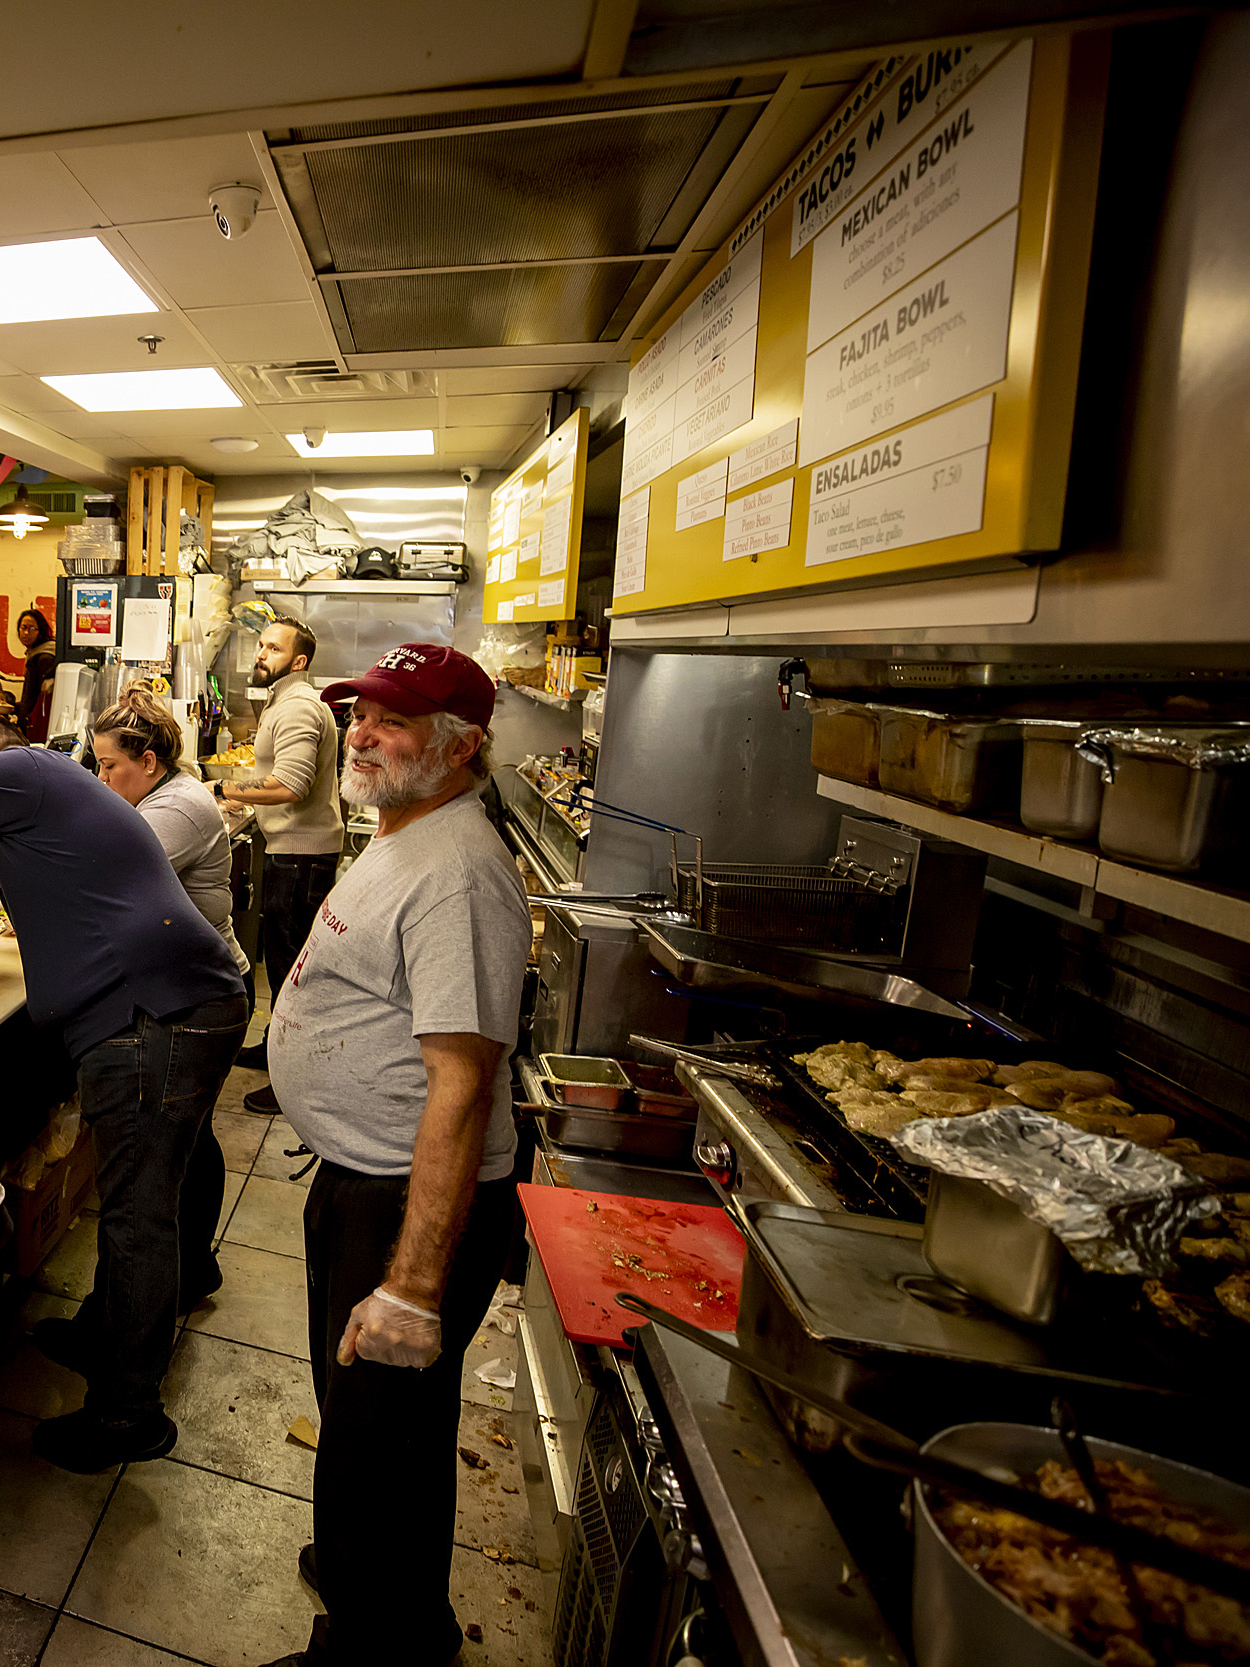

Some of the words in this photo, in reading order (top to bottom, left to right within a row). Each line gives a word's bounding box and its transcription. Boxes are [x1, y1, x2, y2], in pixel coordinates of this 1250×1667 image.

[798, 138, 857, 225] TACOS
[841, 163, 911, 247] MEXICAN
[917, 108, 974, 180] BOWL
[849, 229, 876, 264] choose
[913, 177, 936, 207] with
[844, 240, 895, 290] combination
[897, 222, 910, 248] of
[694, 307, 733, 355] CAMARONES
[839, 317, 890, 371] FAJITA
[896, 279, 950, 336] BOWL
[694, 356, 726, 394] CARNITAS
[848, 361, 880, 388] chicken,
[687, 394, 730, 437] VEGETARIANO
[846, 389, 872, 413] onions
[870, 396, 895, 424] $9.95
[745, 444, 765, 461] Mexican
[767, 435, 778, 449] Rice
[750, 465, 763, 480] Lime
[764, 456, 780, 472] White
[781, 450, 793, 464] Rice
[816, 439, 903, 495] ENSALADAS
[932, 463, 963, 491] $7.50
[742, 497, 756, 512] Black
[757, 493, 773, 506] Beans
[813, 510, 830, 525] Taco
[831, 499, 850, 520] Salad
[741, 518, 755, 532] Pinto
[756, 514, 771, 527] Beans
[827, 525, 838, 537] one
[839, 519, 855, 537] meat,
[856, 514, 879, 530] lettuce,
[880, 507, 905, 524] cheese,
[730, 538, 748, 555] Refried
[749, 535, 763, 550] Pinto
[764, 532, 779, 546] Beans
[826, 545, 838, 554] sour
[839, 537, 859, 552] cream,
[860, 534, 874, 551] pico
[876, 529, 883, 542] de
[885, 525, 903, 545] gallo
[378, 653, 406, 670] H
[403, 662, 417, 671] 36
[327, 915, 348, 936] DAY
